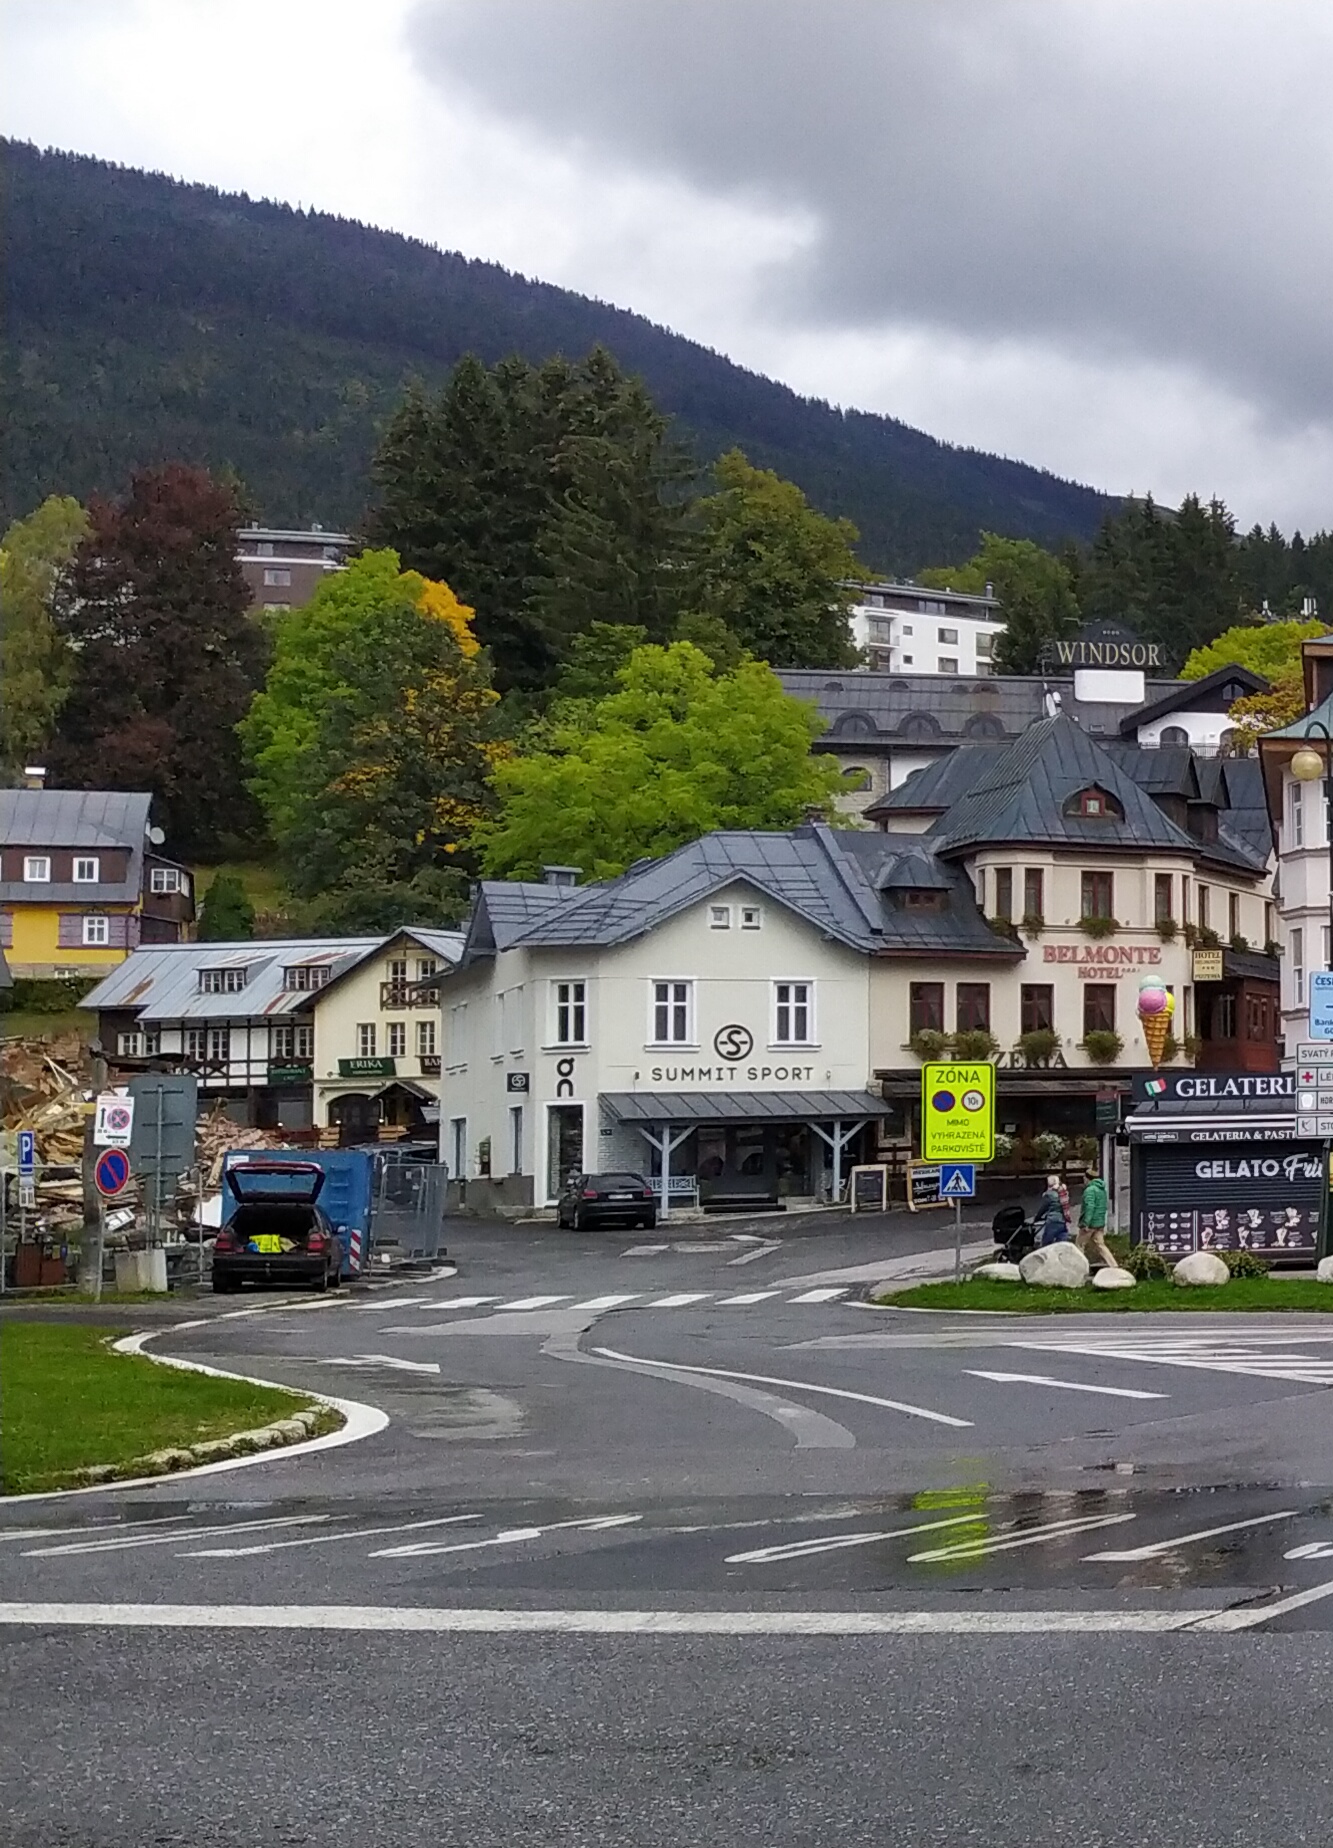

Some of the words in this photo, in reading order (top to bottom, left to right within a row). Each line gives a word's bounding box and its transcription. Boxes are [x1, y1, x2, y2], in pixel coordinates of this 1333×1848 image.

[1056, 641, 1161, 666] WINDSOR
[1043, 944, 1163, 965] BELMONTE
[1195, 951, 1221, 959] HOTEL
[1078, 966, 1123, 980] HOTEL
[1302, 1048, 1329, 1058] SVATÝ
[350, 1060, 384, 1069] ERIKA
[651, 1066, 738, 1081] SUMMIT
[747, 1066, 814, 1081] SPORT
[935, 1067, 981, 1083] ZÓNA
[1175, 1076, 1298, 1097] GELATERI
[946, 1119, 970, 1127] MIMO
[931, 1130, 986, 1140] VYHRAZENÁ
[1191, 1131, 1251, 1141] GELATERIA
[1253, 1130, 1263, 1140] &
[21, 1136, 31, 1161] P
[1195, 1160, 1280, 1179] GELATO
